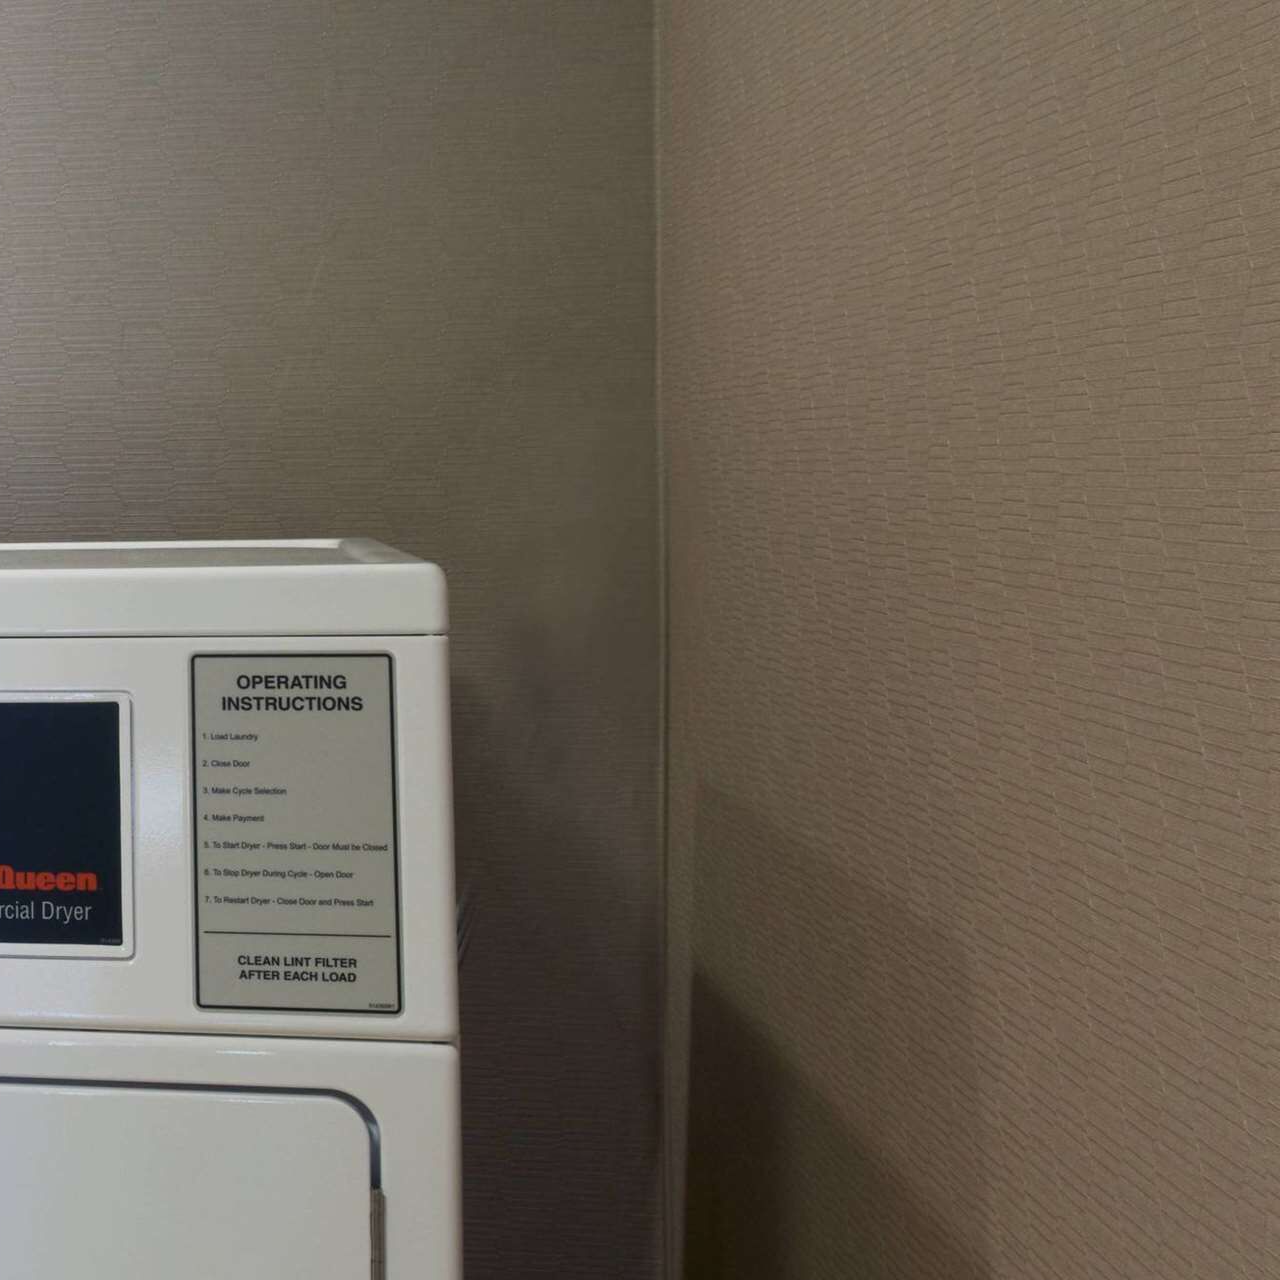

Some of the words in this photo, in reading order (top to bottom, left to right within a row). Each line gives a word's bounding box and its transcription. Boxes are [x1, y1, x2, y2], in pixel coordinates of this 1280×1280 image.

[237, 675, 347, 690] OPERATING
[221, 697, 363, 711] INSTRUCTIONS
[230, 733, 258, 742] Laundry
[232, 787, 253, 796] Cycle
[212, 814, 231, 822] Make
[233, 814, 264, 823] Payment
[242, 842, 260, 851] Dryer
[332, 843, 350, 851] Must
[241, 870, 260, 878] Dryer
[262, 870, 286, 879] During
[287, 870, 308, 879] Cycle
[314, 871, 334, 880] Open
[214, 896, 222, 904] To
[251, 897, 270, 906] Dryer
[299, 898, 316, 906] Door
[356, 899, 373, 907] Start
[41, 901, 91, 924] Dryer
[238, 956, 280, 966] CLEAN
[284, 957, 311, 967] LINT
[315, 958, 357, 968] FILTER
[239, 970, 280, 981] AFTER
[284, 971, 318, 982] EACH
[322, 972, 356, 982] LOAD
